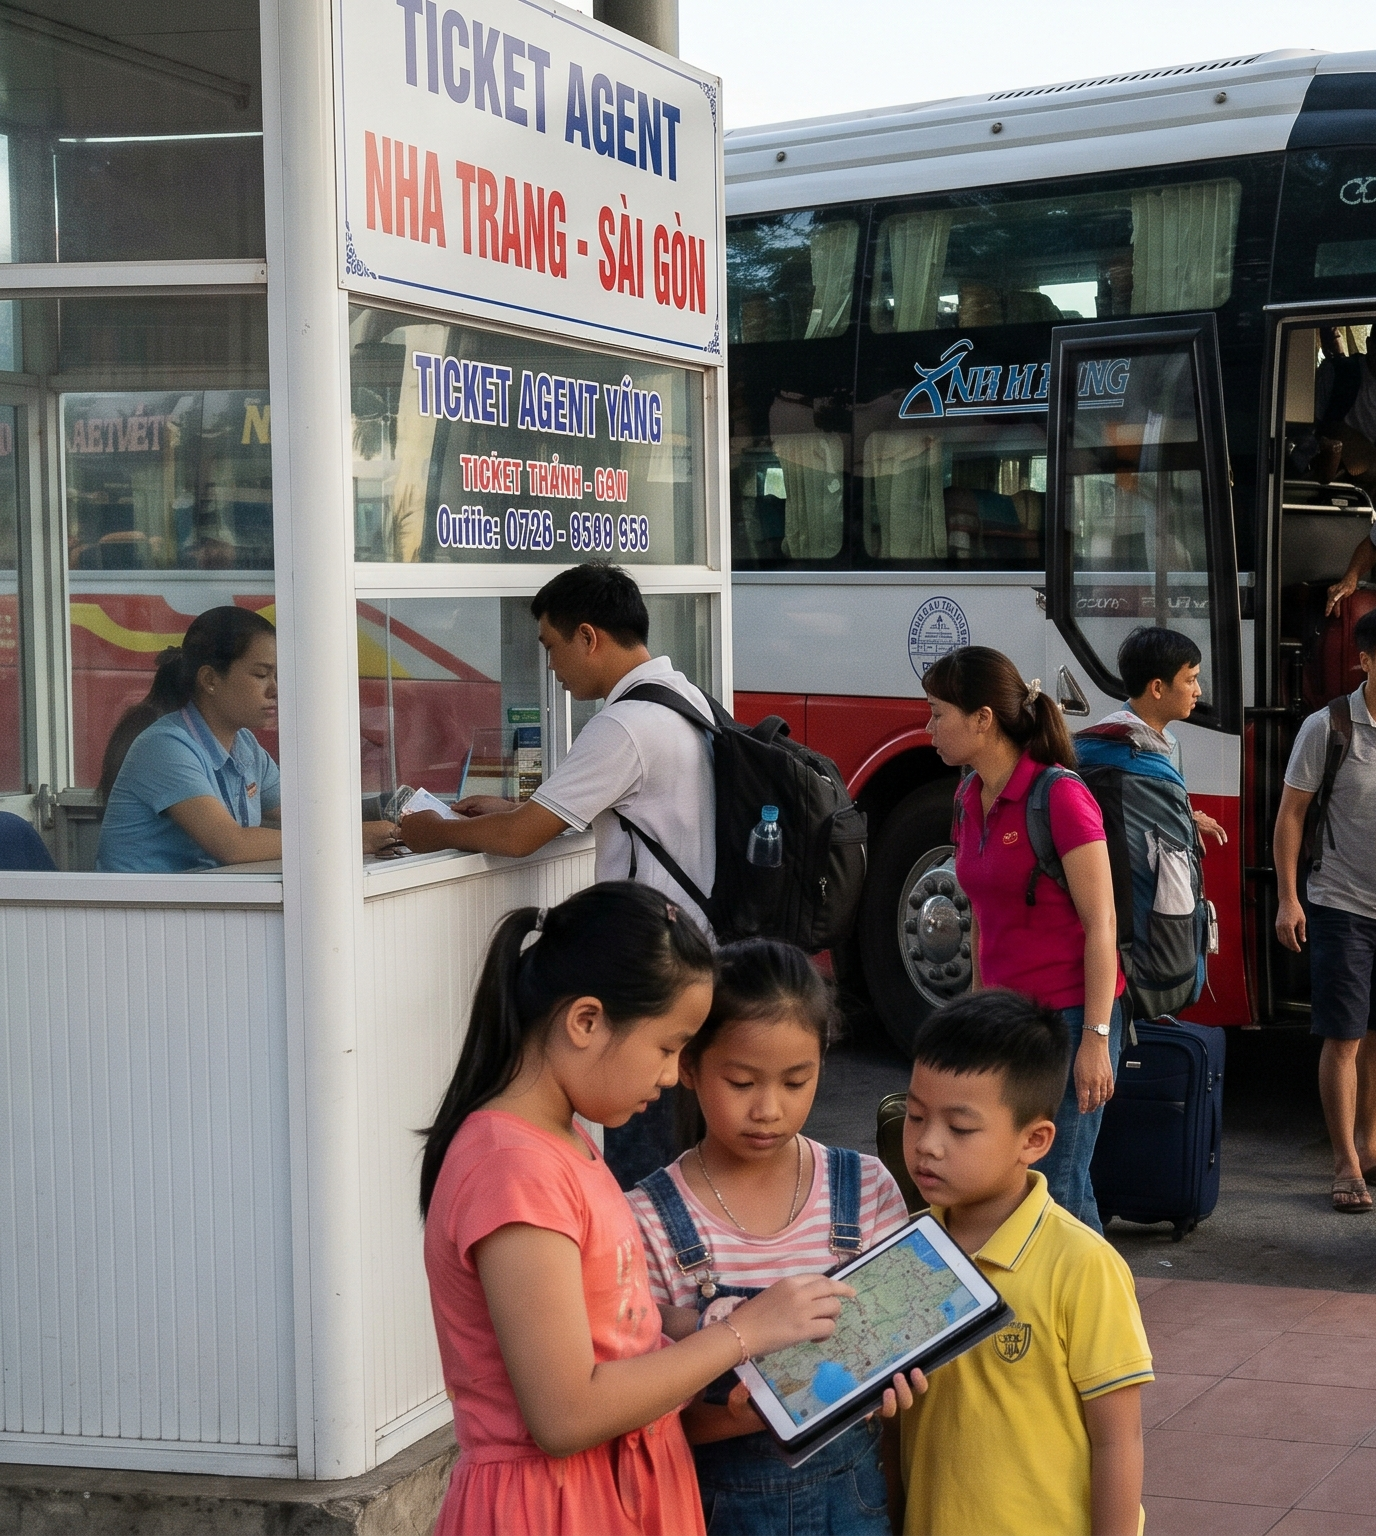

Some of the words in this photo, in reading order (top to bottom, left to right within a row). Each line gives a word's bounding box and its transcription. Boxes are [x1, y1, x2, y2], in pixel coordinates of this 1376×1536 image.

[396, 0, 550, 135] TICKET
[564, 61, 681, 183] AGENT
[364, 130, 447, 249] NHA
[456, 160, 568, 280] TRANG
[598, 193, 645, 299] SÀI
[653, 211, 707, 316] GÒN
[413, 351, 513, 428] TICKET
[518, 369, 600, 438] AGENT
